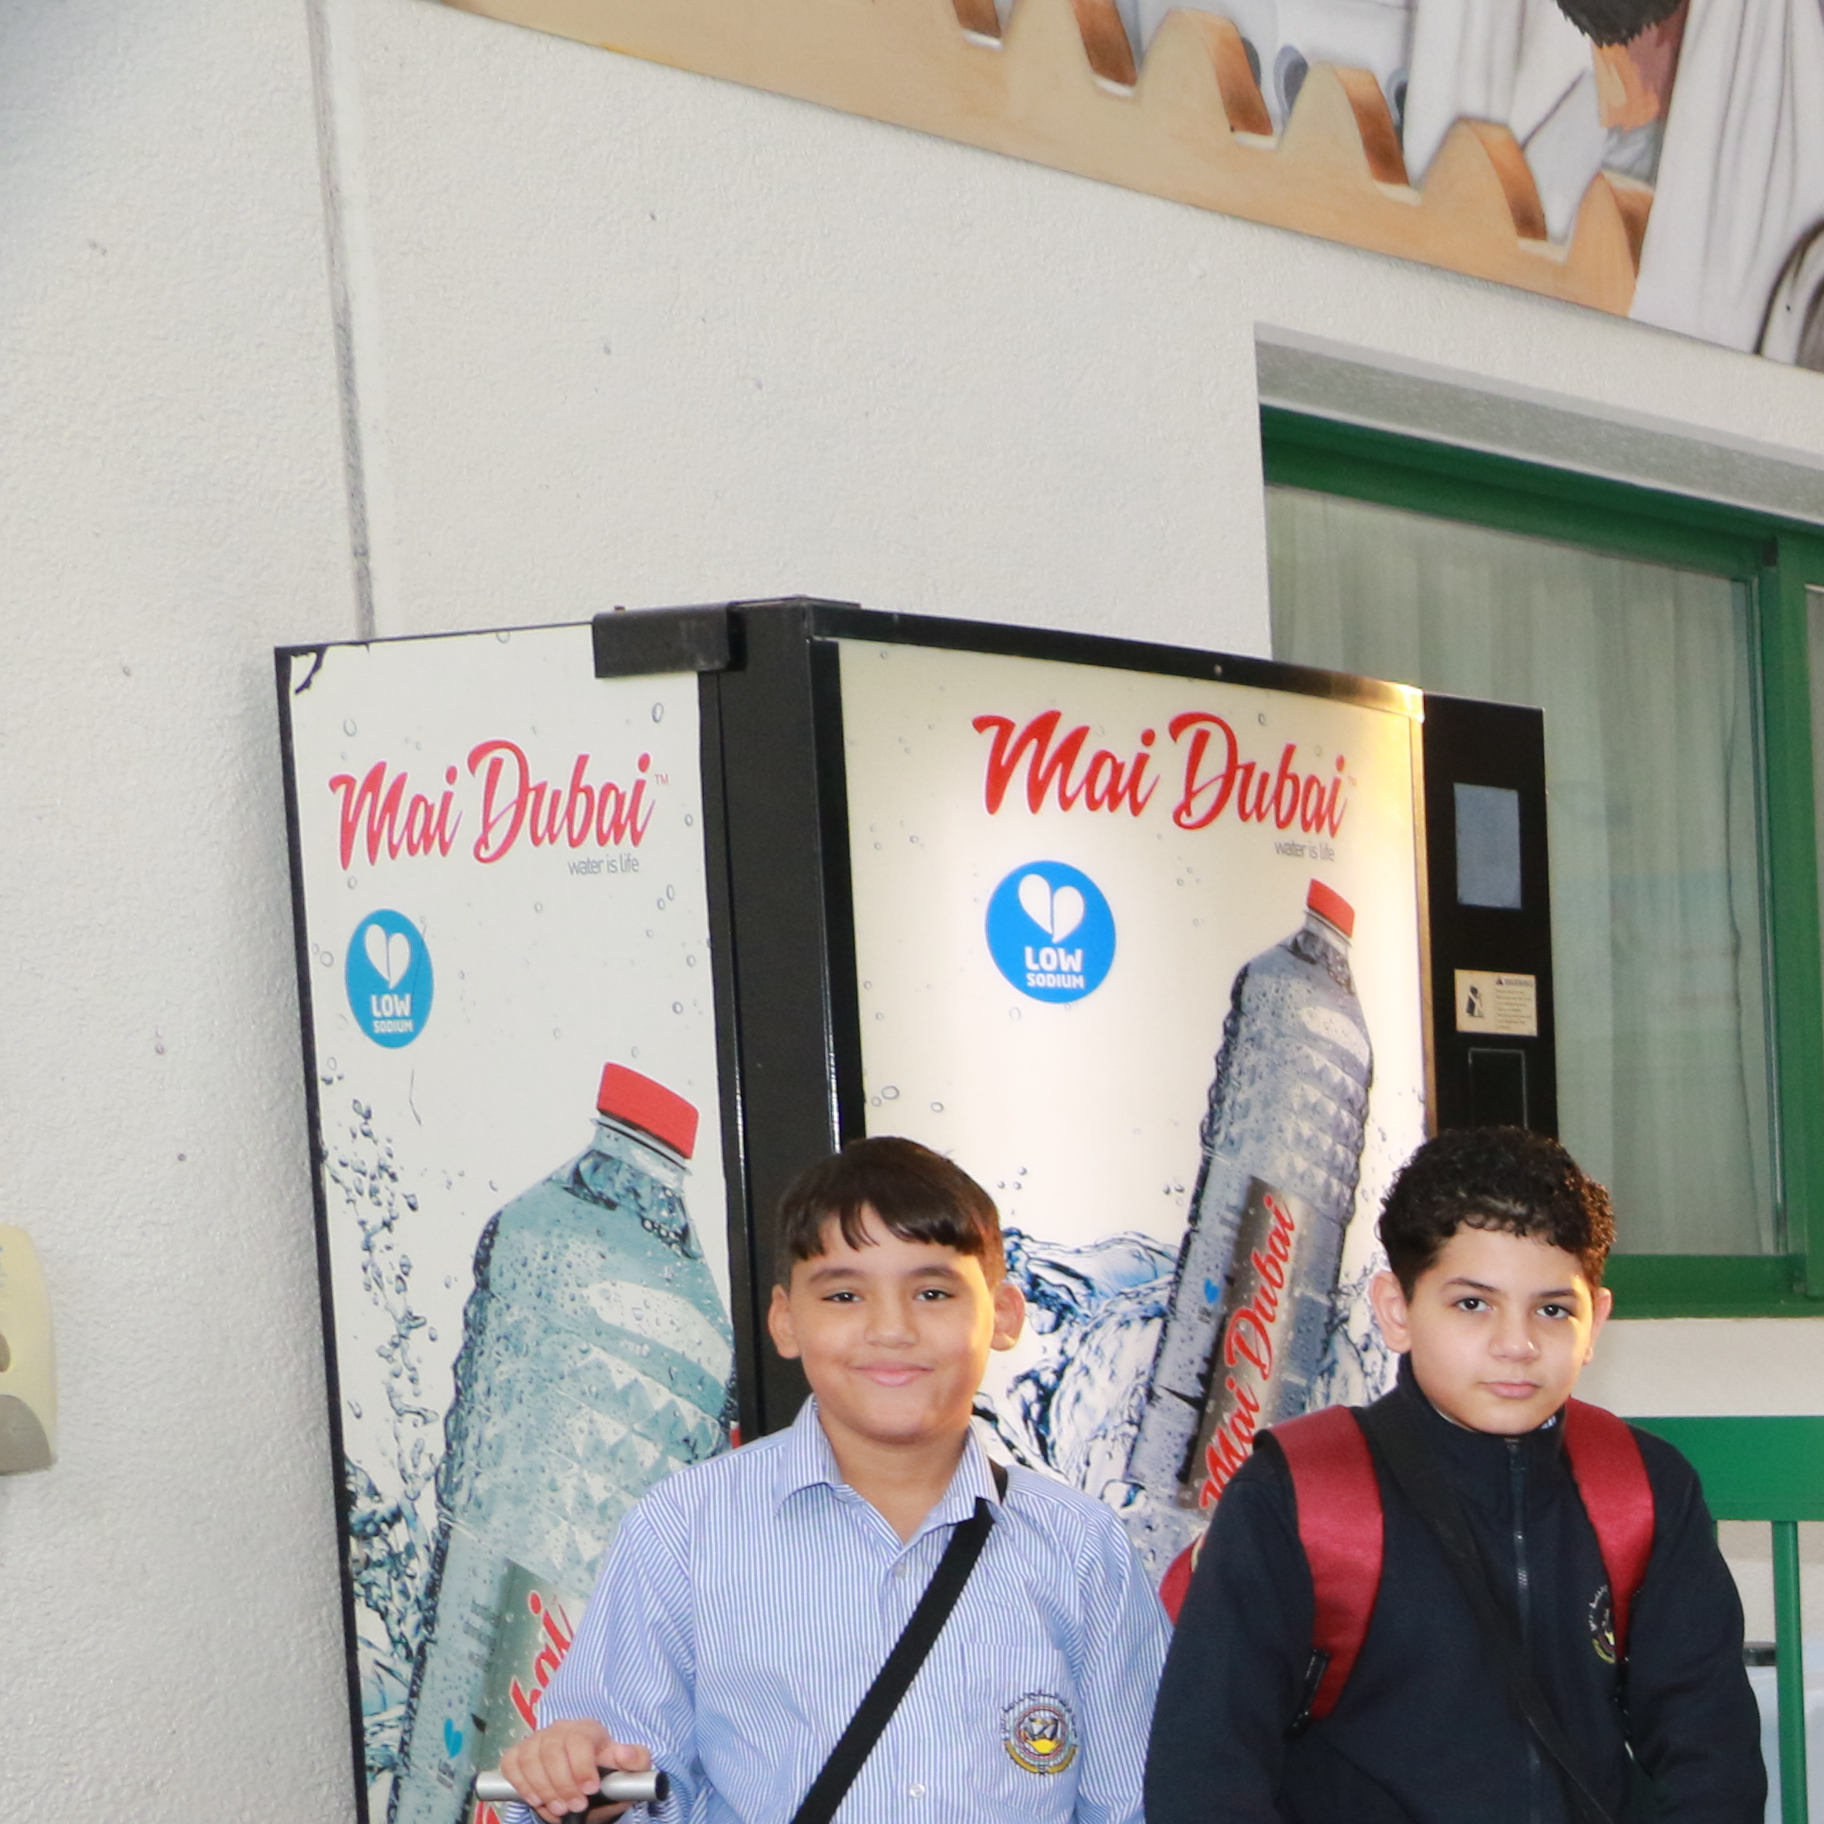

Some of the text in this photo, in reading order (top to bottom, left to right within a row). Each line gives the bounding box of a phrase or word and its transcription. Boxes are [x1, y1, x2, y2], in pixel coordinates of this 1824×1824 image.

[973, 709, 1348, 839] Mai Dubai
[328, 760, 463, 871] Mai
[467, 739, 656, 864] Dubai
[1274, 841, 1307, 858] water
[1309, 841, 1318, 859] is
[567, 853, 640, 876] water is life
[1024, 945, 1083, 973] LOW
[1026, 972, 1086, 990] SODIUM
[370, 993, 412, 1018] LOW
[372, 1018, 414, 1033] SODIUM
[1224, 1193, 1296, 1382] Dubai
